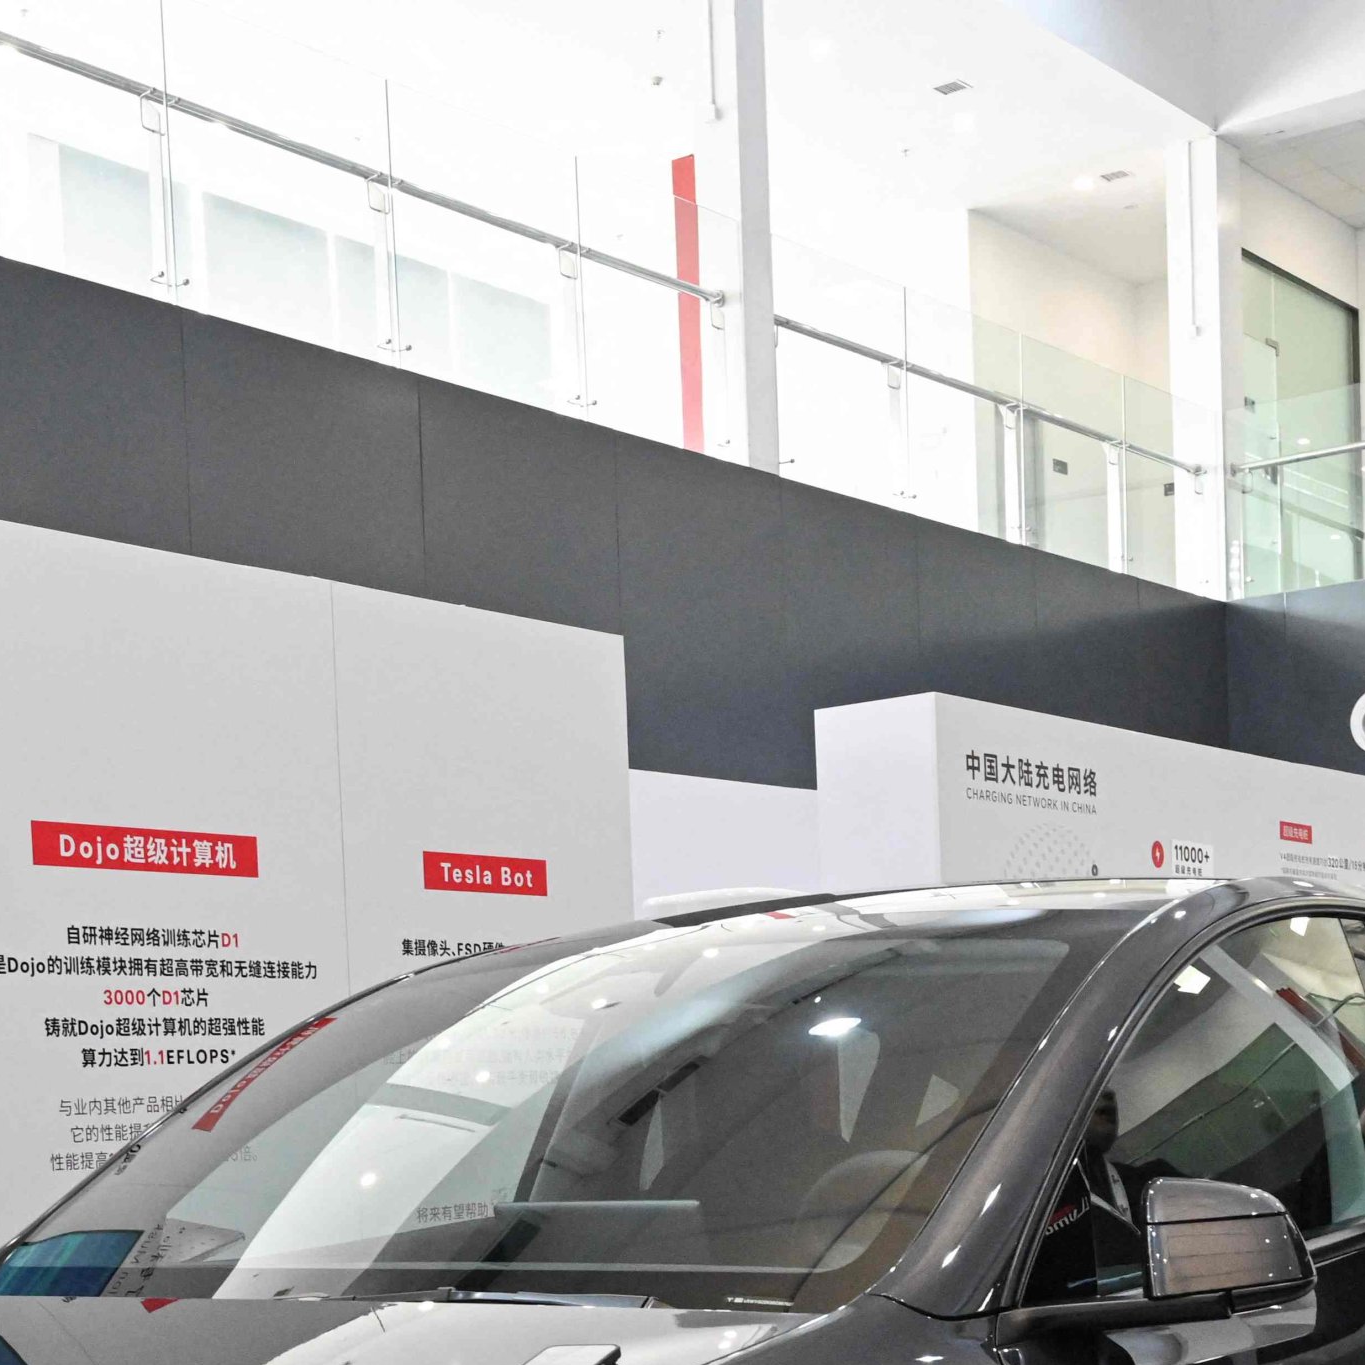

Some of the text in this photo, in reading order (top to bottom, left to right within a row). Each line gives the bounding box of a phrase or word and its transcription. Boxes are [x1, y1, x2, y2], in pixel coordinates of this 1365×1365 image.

[966, 749, 1097, 797] 中国大陆充电网络
[966, 787, 1097, 815] CHARGING NETWORK IN CHINA
[59, 833, 237, 870] Dojo超级计算机
[1174, 845, 1210, 864] 11000+
[440, 862, 533, 888] Tesla Bot
[66, 925, 239, 949] 自研神经网络训练芯片D1
[103, 988, 209, 1008] 3000个D1芯片
[45, 1017, 266, 1040] 铸就Dojo超级计算机的超强性能
